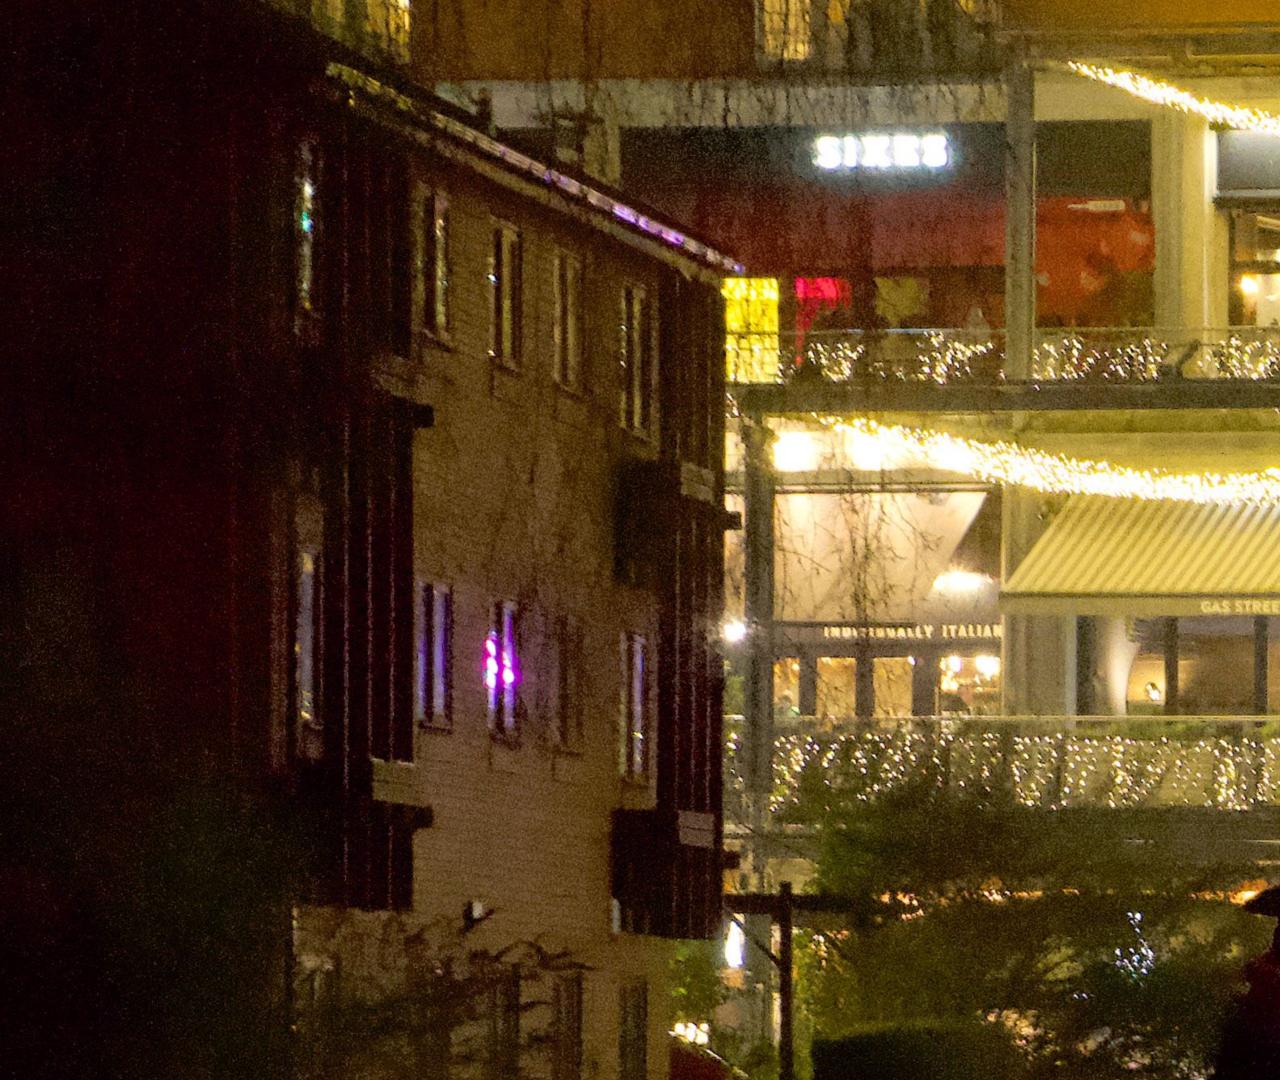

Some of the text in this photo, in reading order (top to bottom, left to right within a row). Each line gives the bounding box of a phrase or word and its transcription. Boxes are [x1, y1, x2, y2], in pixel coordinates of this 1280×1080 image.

[814, 133, 949, 169] SIXES
[1200, 600, 1231, 614] GAS
[942, 624, 1003, 639] ITALIAN
